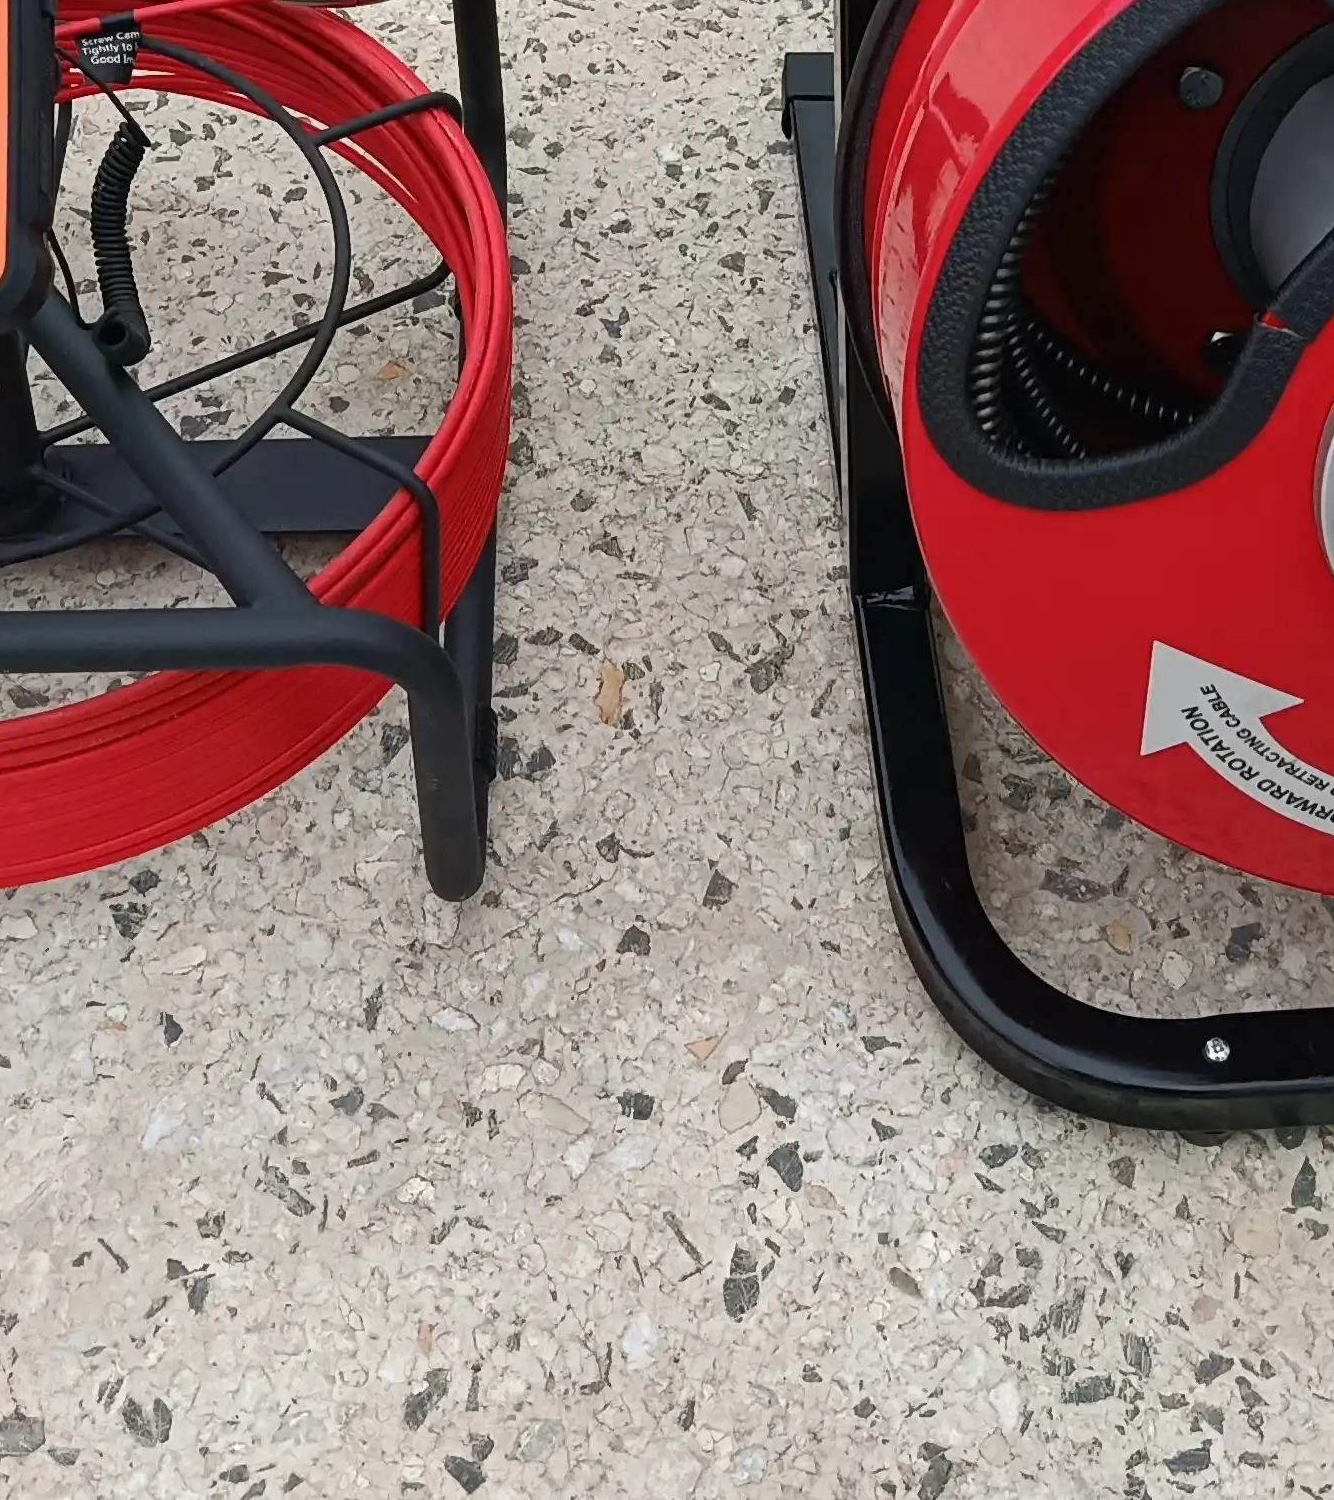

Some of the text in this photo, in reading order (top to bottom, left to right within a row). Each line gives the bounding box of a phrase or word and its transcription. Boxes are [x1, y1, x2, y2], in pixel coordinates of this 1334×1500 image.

[81, 42, 120, 56] Tightly
[90, 54, 121, 65] Good
[1199, 683, 1241, 729] CABLE
[1180, 705, 1261, 782] ROTATION
[1235, 726, 1326, 793] RETRACTING
